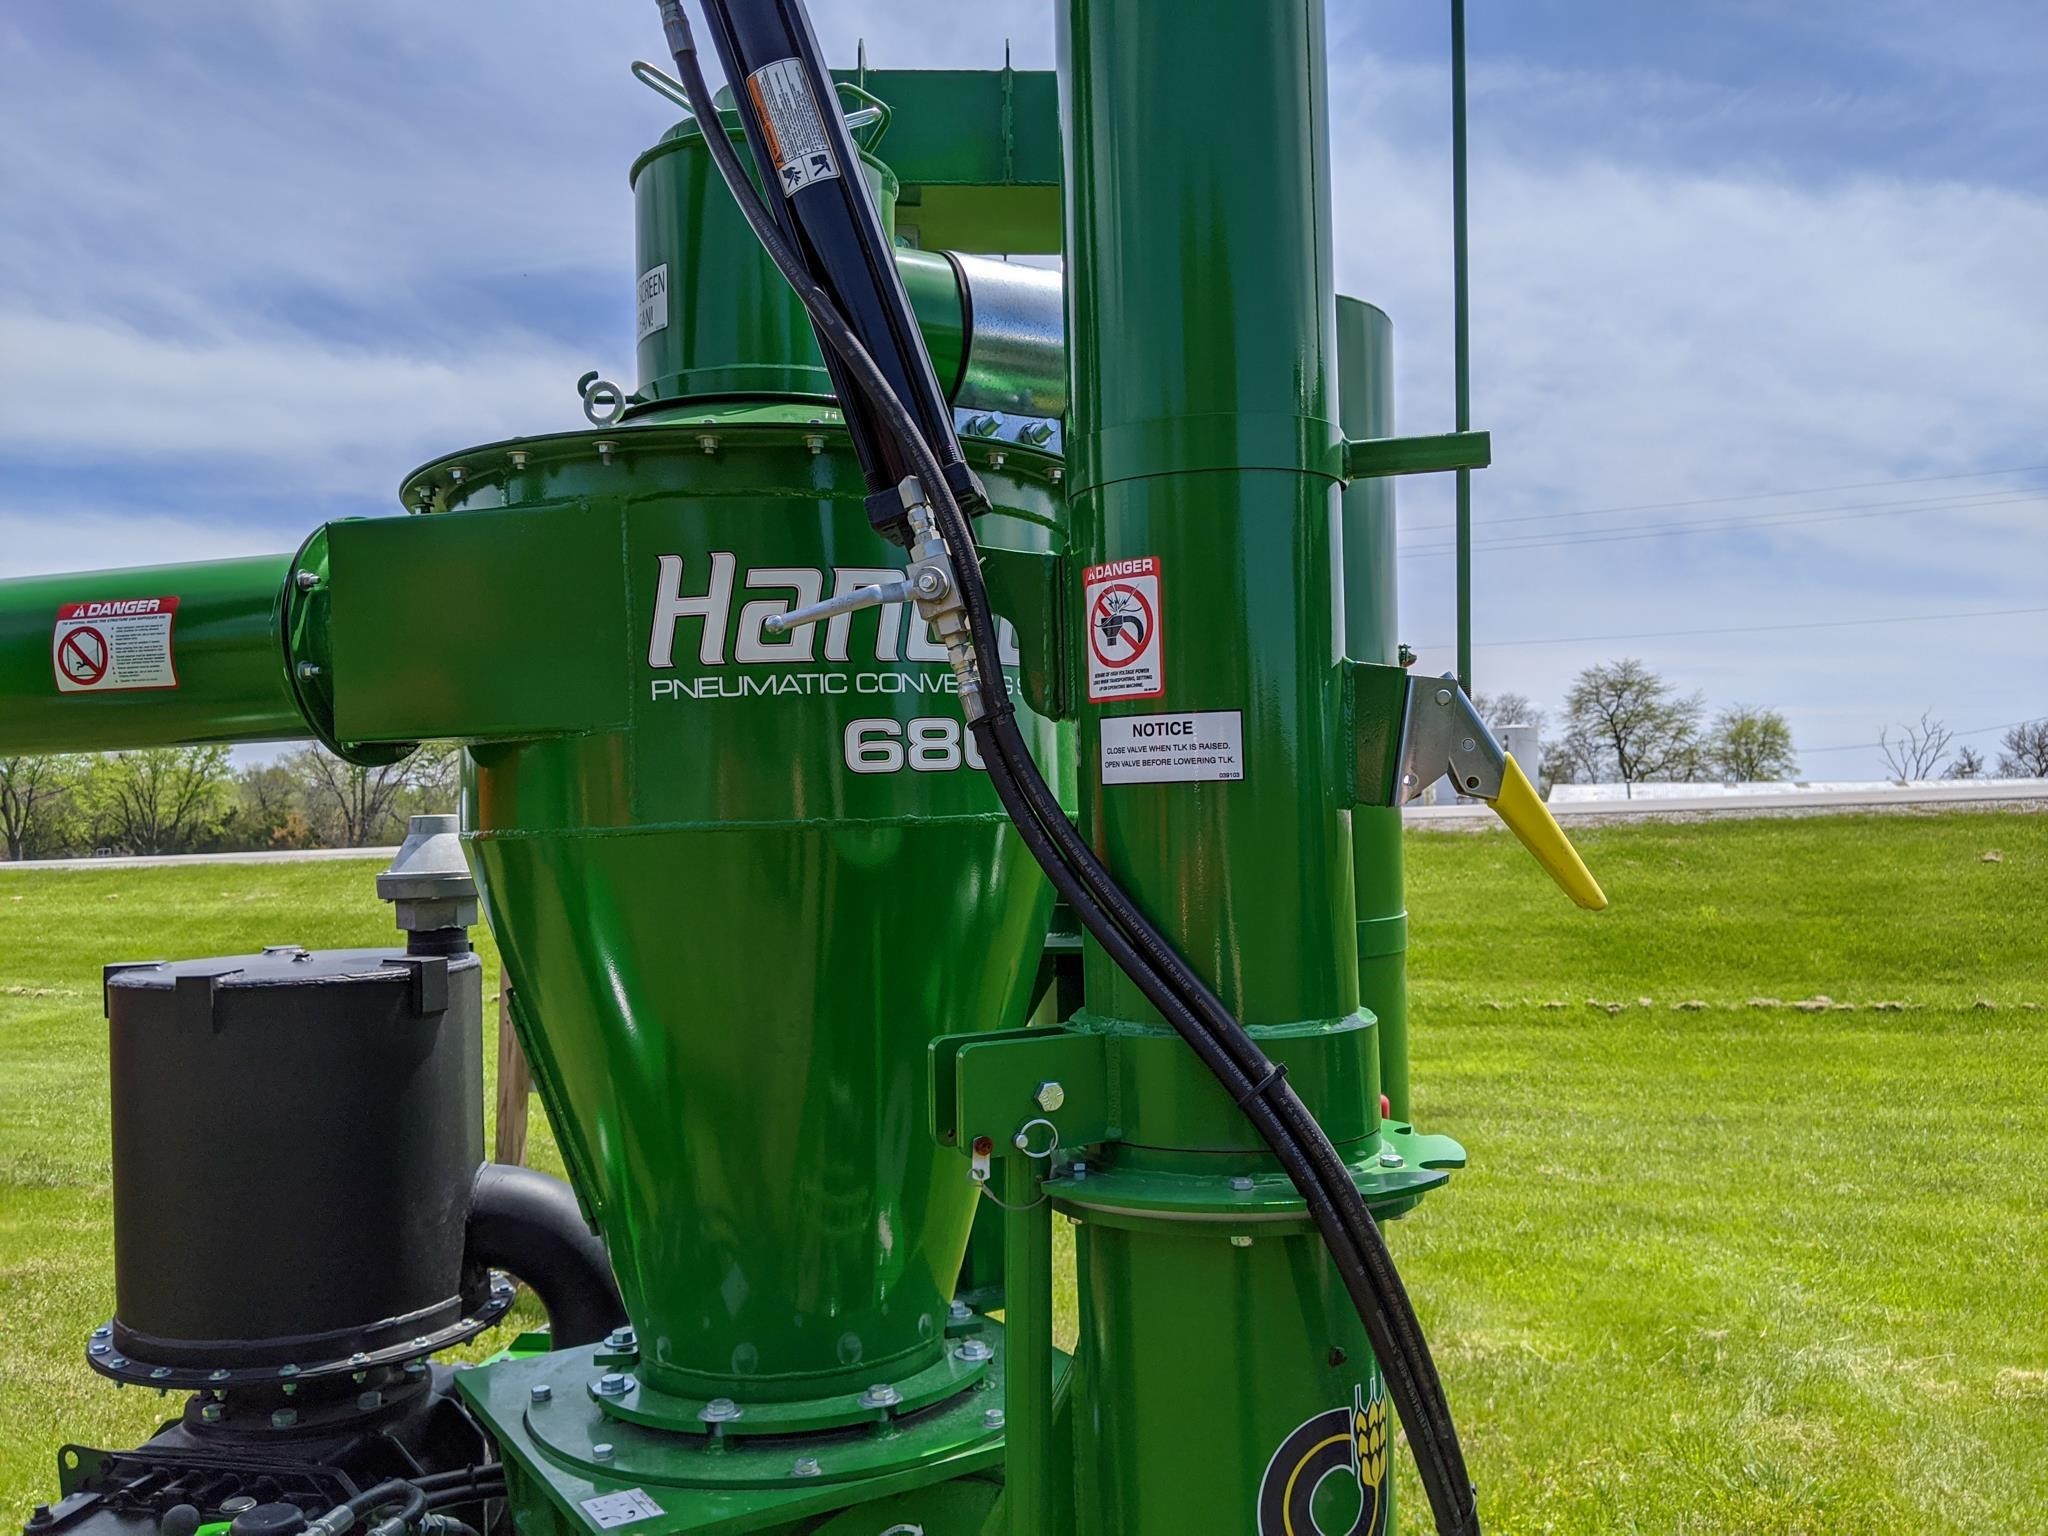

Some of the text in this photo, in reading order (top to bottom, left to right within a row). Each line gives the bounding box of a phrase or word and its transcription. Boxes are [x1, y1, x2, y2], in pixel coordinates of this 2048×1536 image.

[1096, 558, 1153, 579] DANGER
[87, 599, 160, 616] DANGER
[651, 672, 848, 701] PNEUMATIC
[1132, 721, 1194, 738] NOTICE
[1106, 742, 1231, 755] CLOSE VALVE WHEN TLK IS RAISED.
[1105, 756, 1235, 769] OPEN VALVE BEFORE LOWERING TLK.
